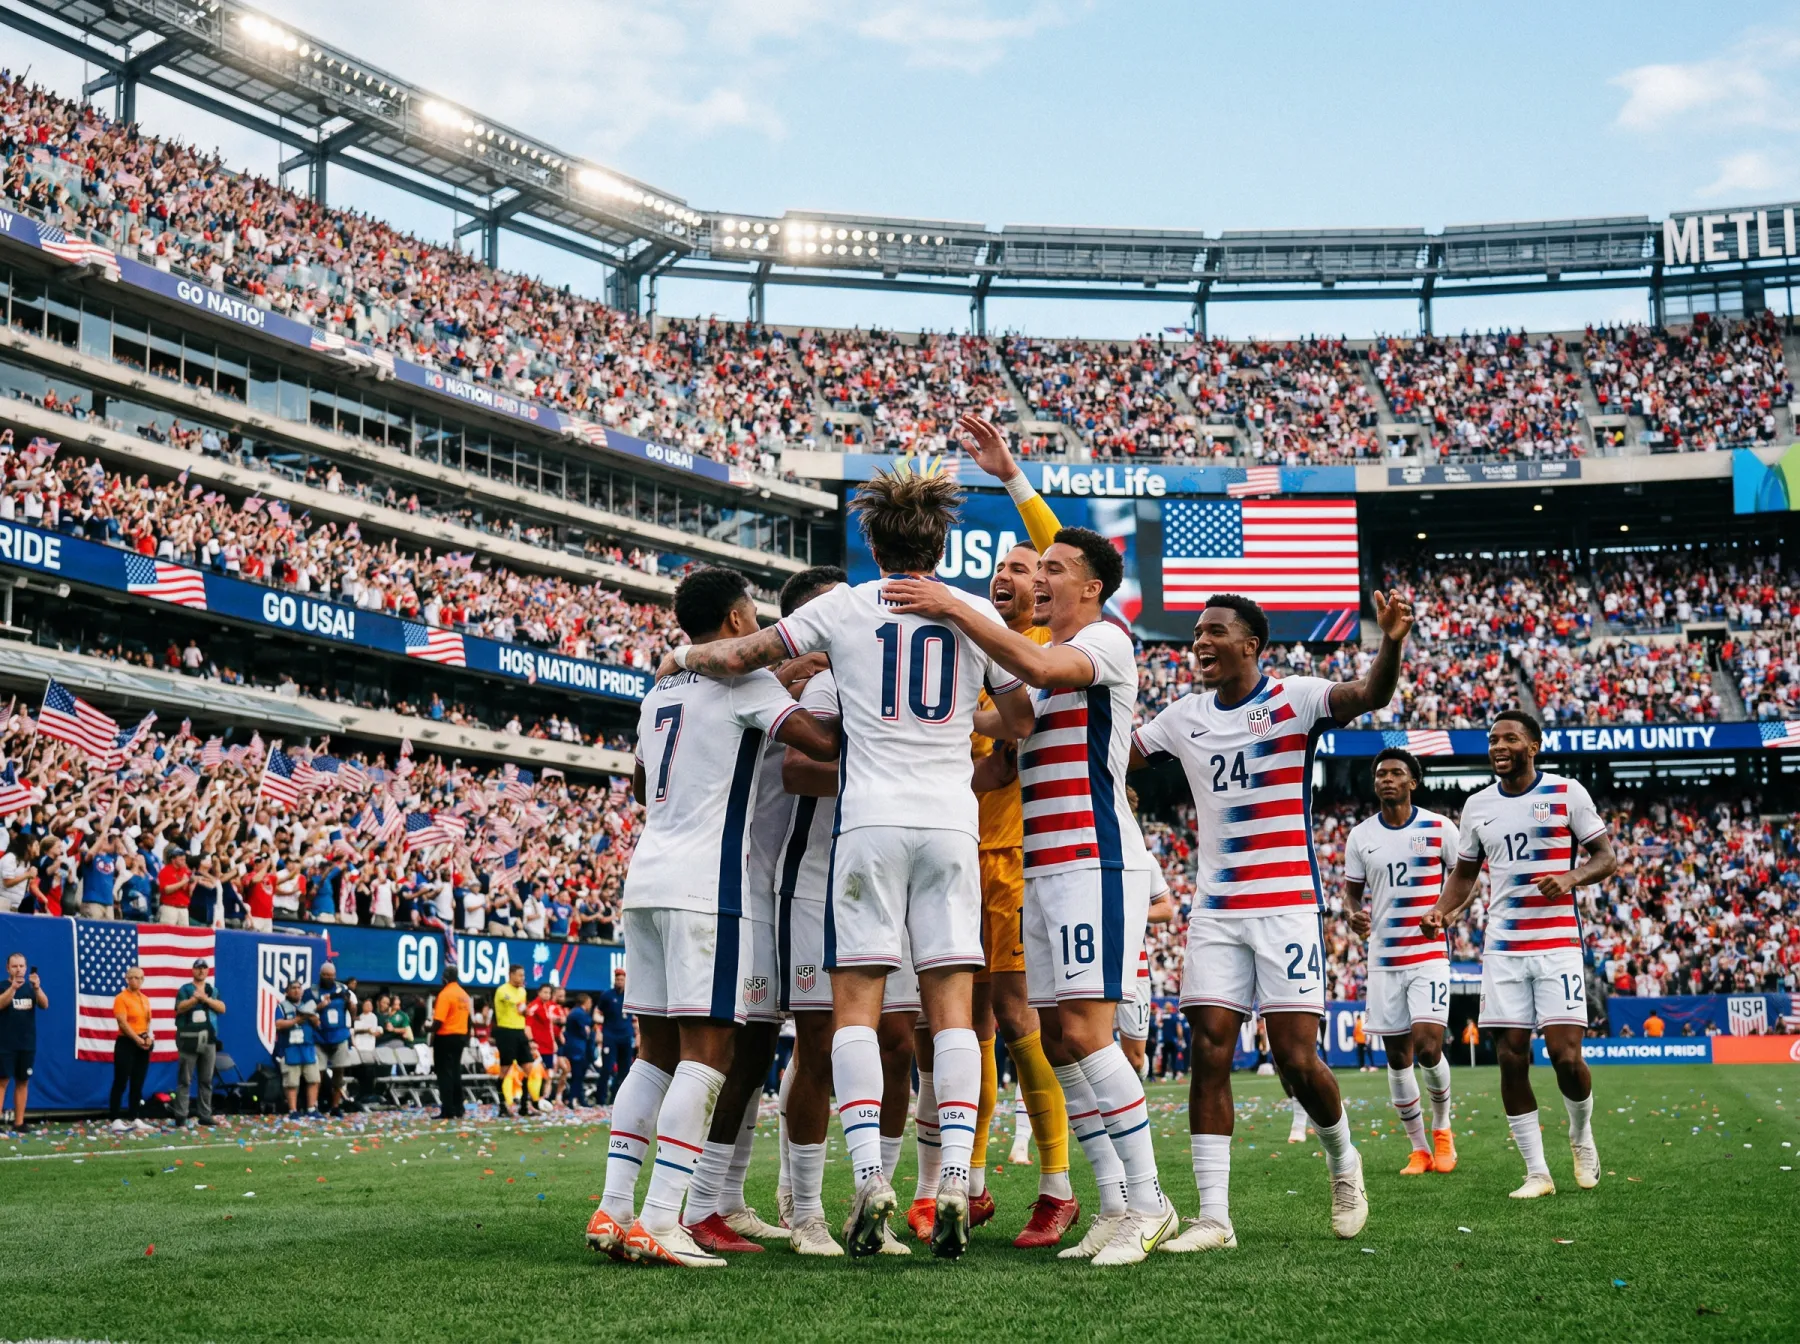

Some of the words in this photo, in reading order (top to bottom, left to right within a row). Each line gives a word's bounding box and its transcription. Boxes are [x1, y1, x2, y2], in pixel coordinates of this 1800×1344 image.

[177, 281, 204, 304] GO
[207, 291, 265, 328] NATIO!
[446, 377, 493, 406] NATION
[645, 443, 664, 460] GO
[664, 448, 693, 470] USA!
[1041, 464, 1167, 496] MetLife
[936, 529, 1018, 579] USA
[263, 592, 297, 626] GO
[301, 600, 355, 640] USA!
[499, 646, 535, 676] HOS
[537, 655, 597, 689] NATION
[599, 668, 646, 699] PRIDE
[875, 621, 960, 724] 10
[1249, 709, 1269, 721] USA
[655, 703, 684, 802] 7
[1566, 729, 1635, 751] TEAM
[1640, 726, 1716, 749] UNITY
[1210, 751, 1249, 792] 24
[1503, 832, 1530, 861] 12
[1386, 862, 1408, 887] 12
[1060, 923, 1095, 965] 18
[263, 950, 307, 995] USA
[397, 934, 438, 981] GO
[456, 938, 510, 984] USA
[797, 966, 814, 978] USA
[1285, 943, 1320, 980] 24
[1430, 981, 1447, 1006] 12
[1561, 974, 1583, 1002] 12
[1731, 1000, 1763, 1018] USA
[1607, 1045, 1662, 1058] NATION
[1664, 1045, 1706, 1057] PRIDE
[858, 1110, 879, 1118] USA
[943, 1111, 966, 1120] USA
[610, 1140, 630, 1151] USA
